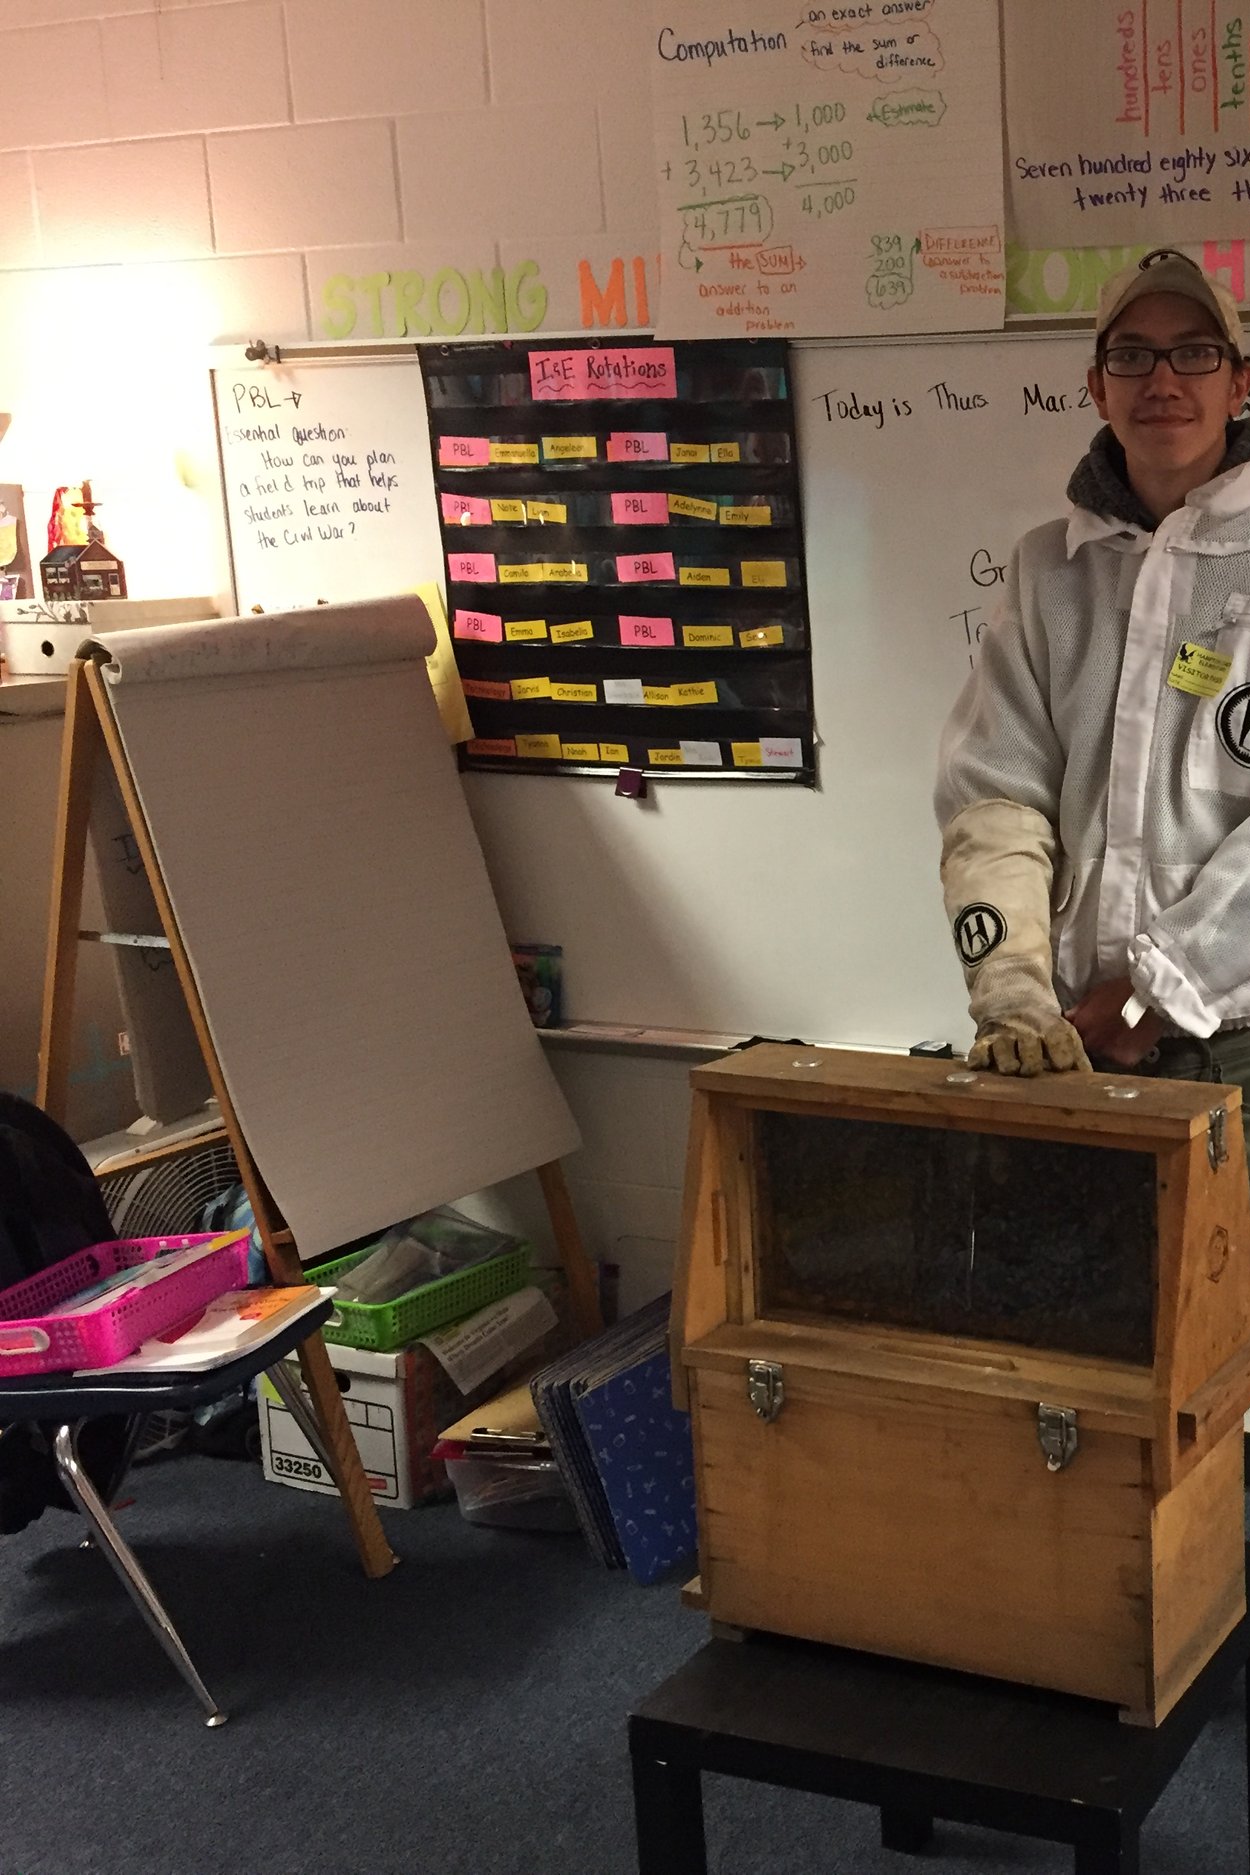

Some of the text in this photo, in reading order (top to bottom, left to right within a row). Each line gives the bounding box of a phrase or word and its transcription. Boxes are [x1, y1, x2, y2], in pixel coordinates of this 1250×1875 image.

[807, 1, 931, 22] an exact answer
[658, 27, 787, 67] Computation
[809, 33, 920, 57] find the sum or
[876, 50, 936, 69] difference
[1115, 10, 1144, 124] hundreds
[1151, 38, 1173, 95] tens
[1192, 26, 1209, 93] ones
[1219, 17, 1245, 110] tenths
[682, 110, 752, 151] 1,356
[1015, 155, 1073, 181] Seven
[1078, 149, 1152, 177] hundred
[1159, 146, 1215, 183] eighty
[684, 156, 759, 197] 3,423
[801, 186, 856, 219] 4,000
[1073, 182, 1148, 213] twenty
[1158, 180, 1212, 204] three
[694, 205, 764, 241] 4,779
[870, 235, 902, 253] 839
[729, 252, 790, 271] the SUM
[874, 256, 905, 273] 200
[321, 259, 548, 339] STRONG
[699, 279, 798, 297] answer to an
[716, 302, 771, 317] addition
[746, 318, 796, 333] problem
[586, 355, 667, 380] Rotations
[233, 383, 281, 413] PBL
[811, 381, 1074, 429] Today is Thurs Mar.
[452, 442, 475, 458] PBL
[625, 439, 650, 455] PBL
[261, 449, 396, 472] How can you plan
[239, 482, 250, 498] a
[302, 475, 326, 494] trip
[335, 468, 361, 489] that
[368, 468, 400, 493] helps
[303, 499, 341, 518] learn
[352, 497, 392, 514] about
[453, 500, 474, 516] PBL
[624, 499, 648, 514] PBL
[725, 510, 750, 523] Emily
[257, 529, 279, 551] the
[283, 525, 314, 547] Civil
[460, 561, 479, 576] PBL
[634, 560, 659, 575] PBL
[466, 616, 487, 633] PBL
[510, 626, 534, 638] Emma
[634, 624, 658, 640] PBL
[556, 687, 594, 698] Christian
[275, 1455, 323, 1480] 33250
